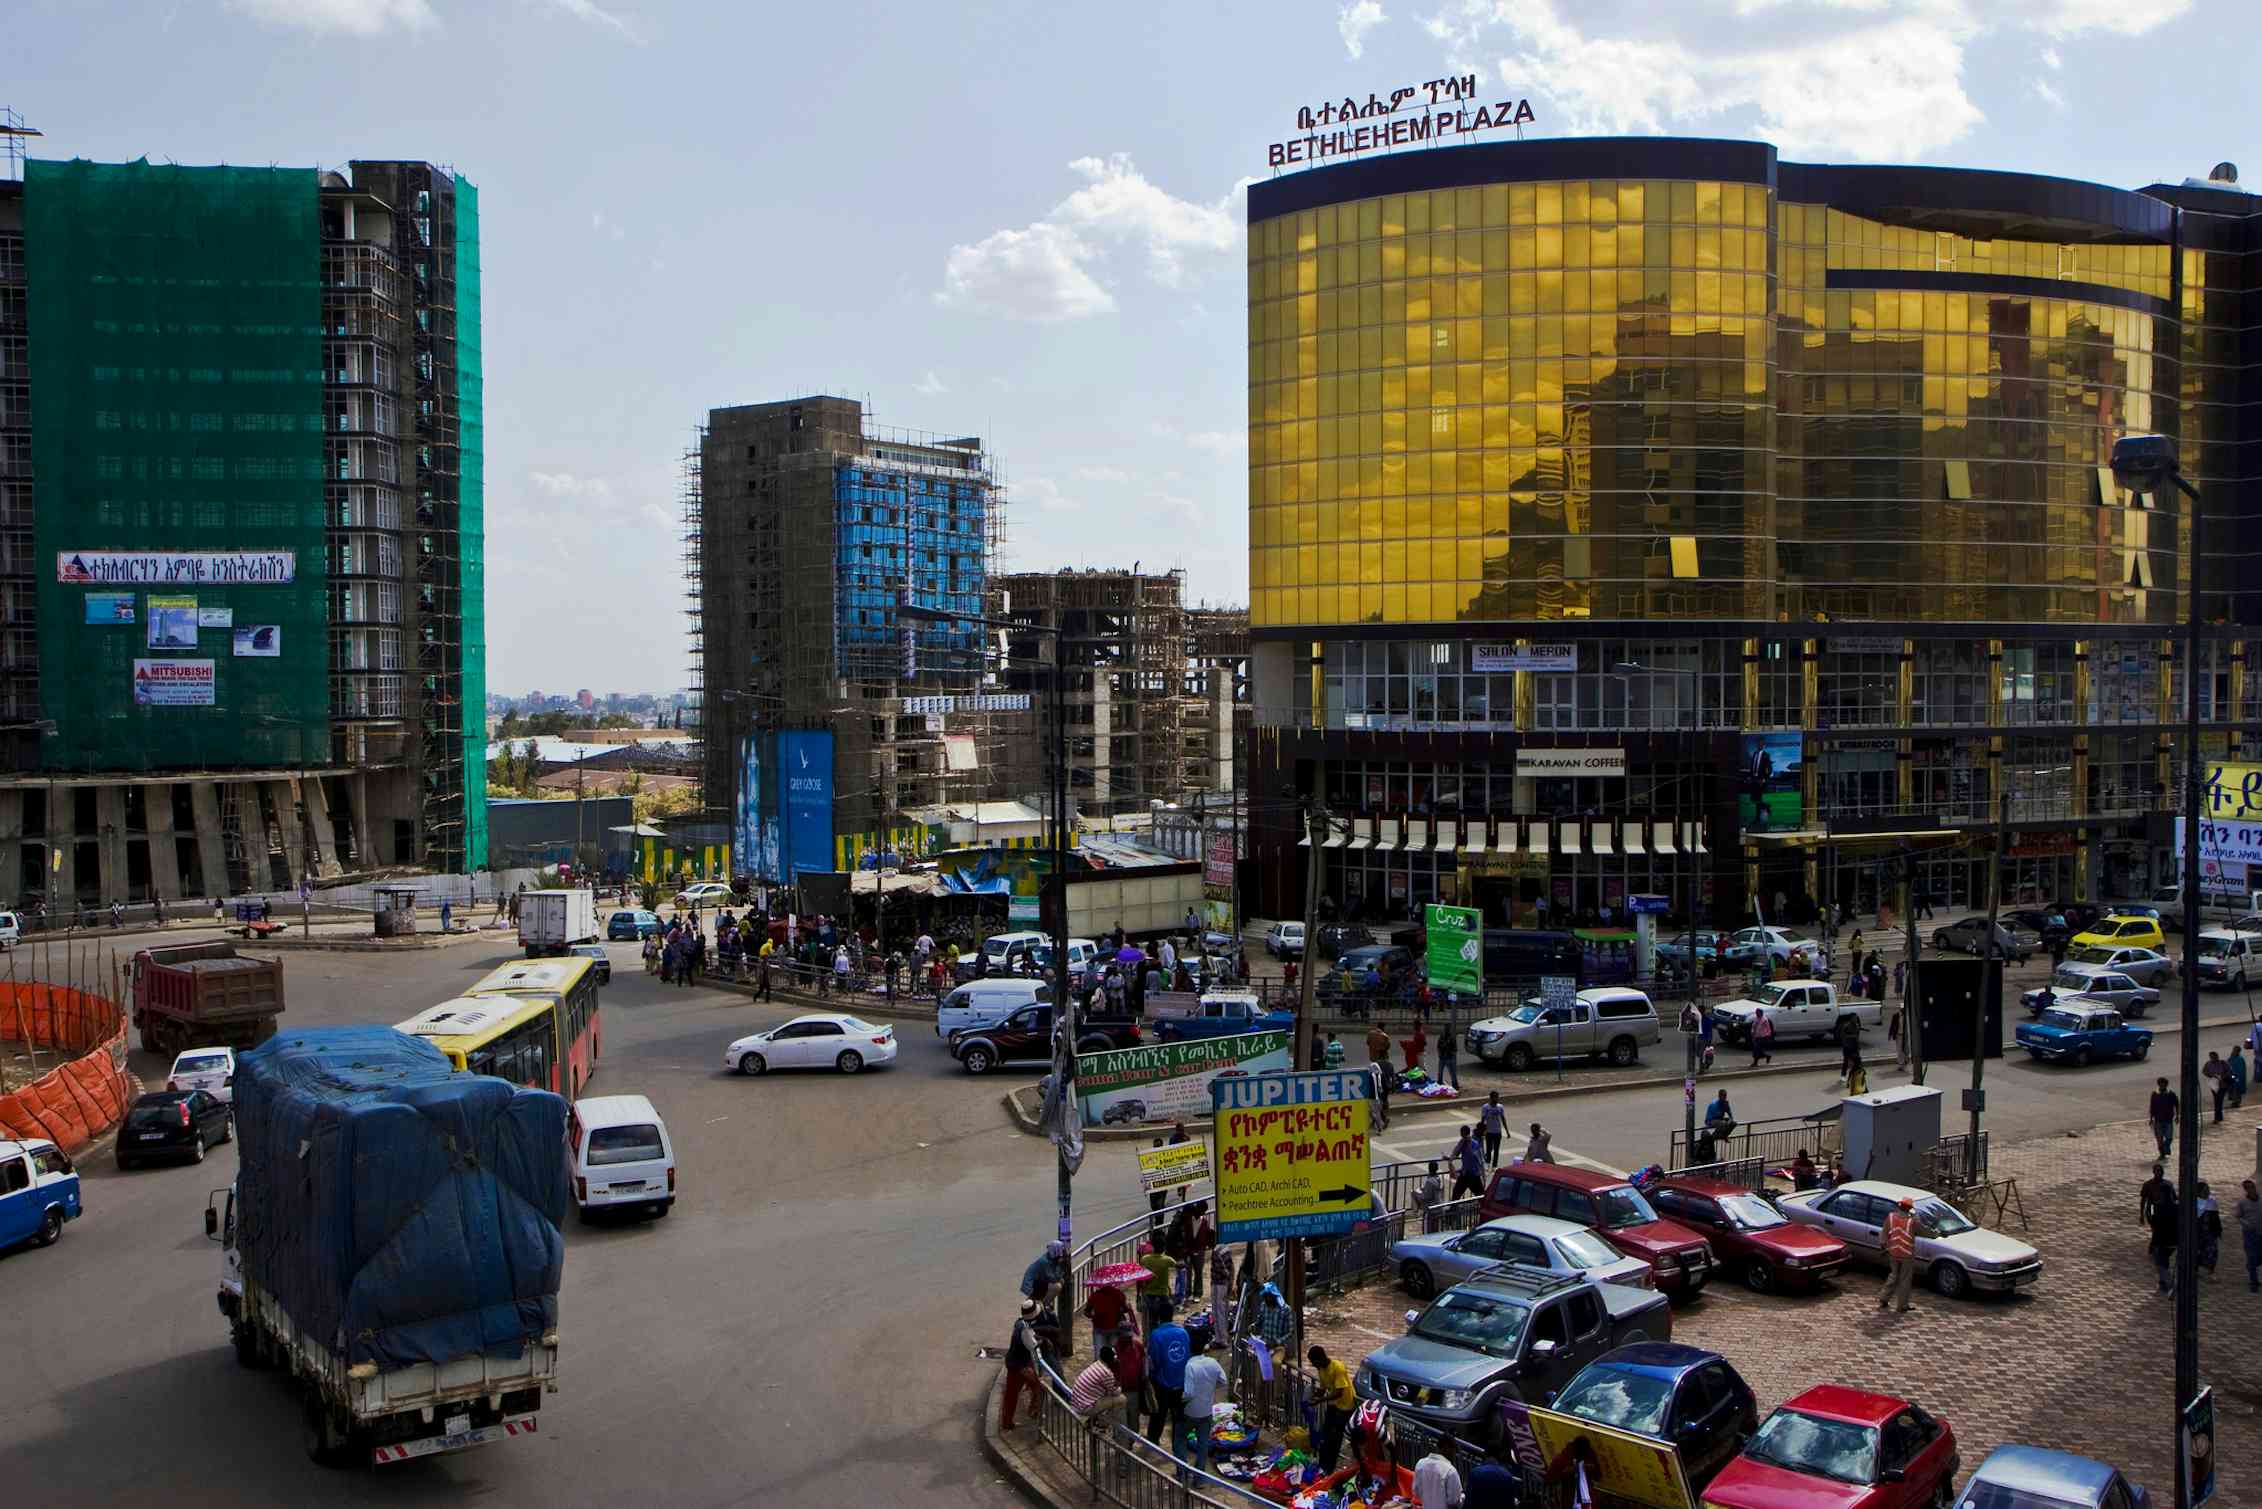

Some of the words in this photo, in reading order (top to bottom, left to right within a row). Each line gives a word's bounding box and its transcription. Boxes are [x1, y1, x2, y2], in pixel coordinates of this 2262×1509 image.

[1268, 115, 1431, 167] BETHLEHEM
[1436, 99, 1536, 137] PLAZA
[1529, 646, 1570, 657] MERON
[151, 666, 212, 676] MITSUBISHI
[1531, 758, 1581, 768] KARAVAN
[1584, 758, 1620, 768] COFFEE
[1219, 1074, 1365, 1109] JUPITER
[1228, 1184, 1248, 1195] Auto
[1270, 1178, 1291, 1191] Archi
[1229, 1198, 1268, 1212] Peachtree
